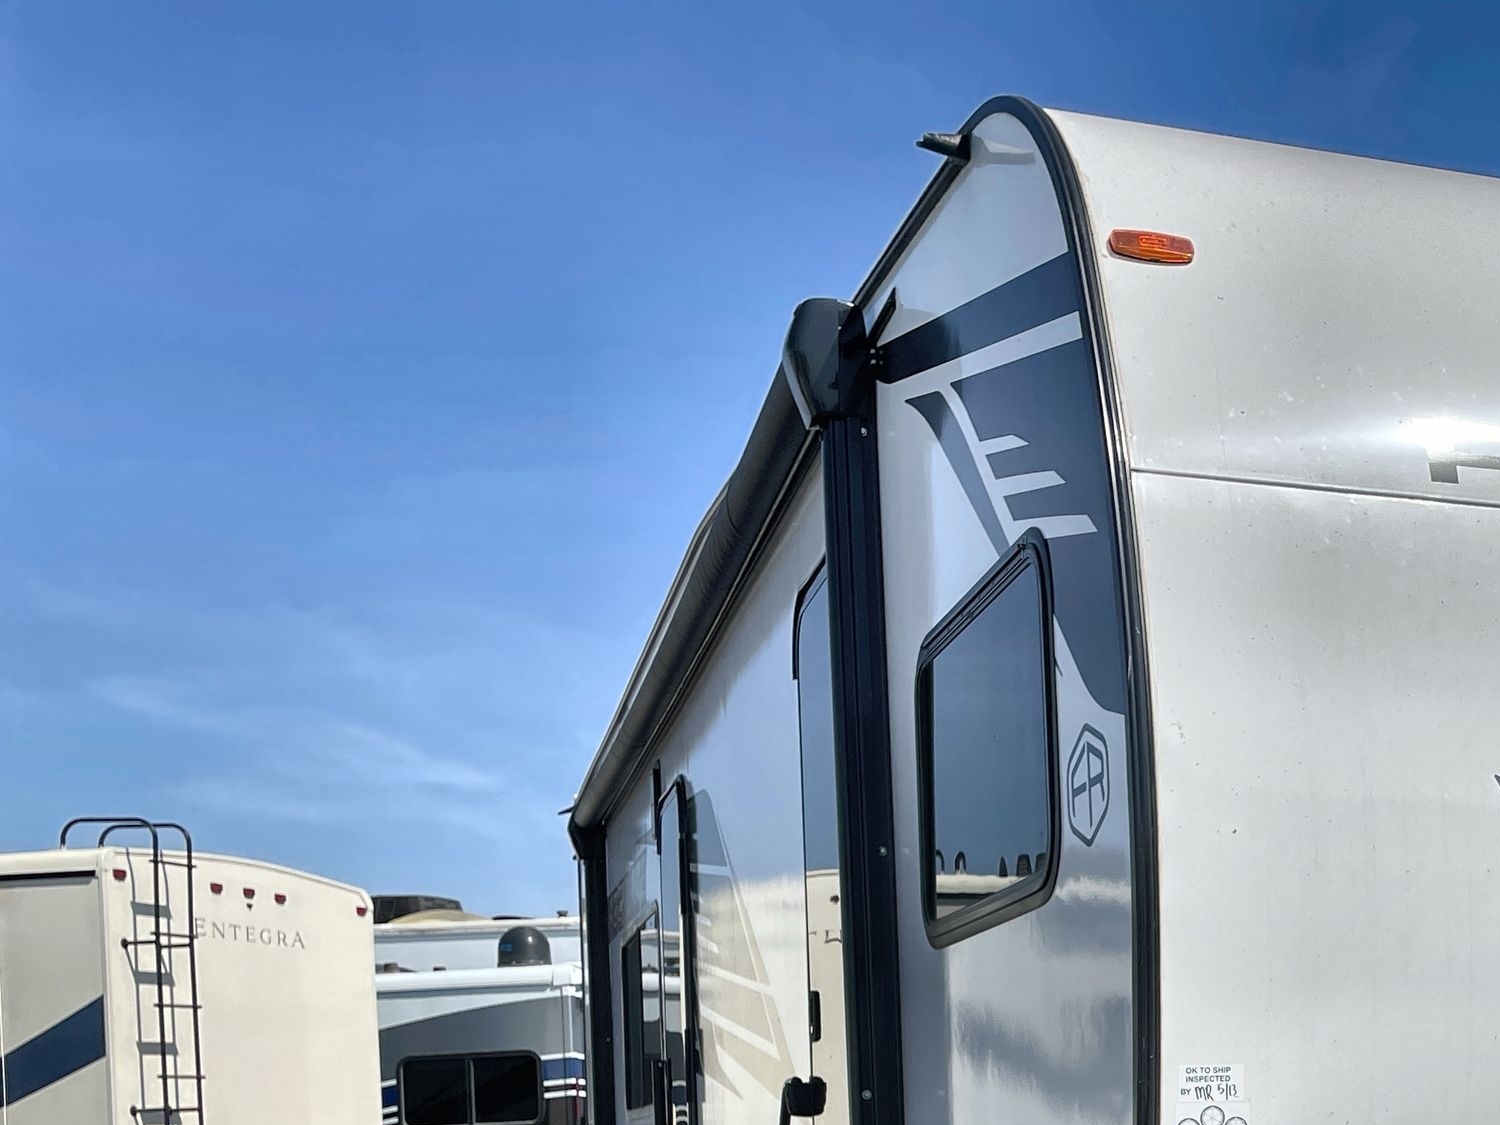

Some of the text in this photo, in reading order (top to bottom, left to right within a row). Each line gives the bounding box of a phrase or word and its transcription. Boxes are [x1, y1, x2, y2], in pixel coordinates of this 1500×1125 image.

[194, 917, 306, 950] ENTEGRA
[1200, 1066, 1211, 1074] TO
[1213, 1066, 1231, 1074] SHIP
[1185, 1075, 1231, 1083] INSPECTED
